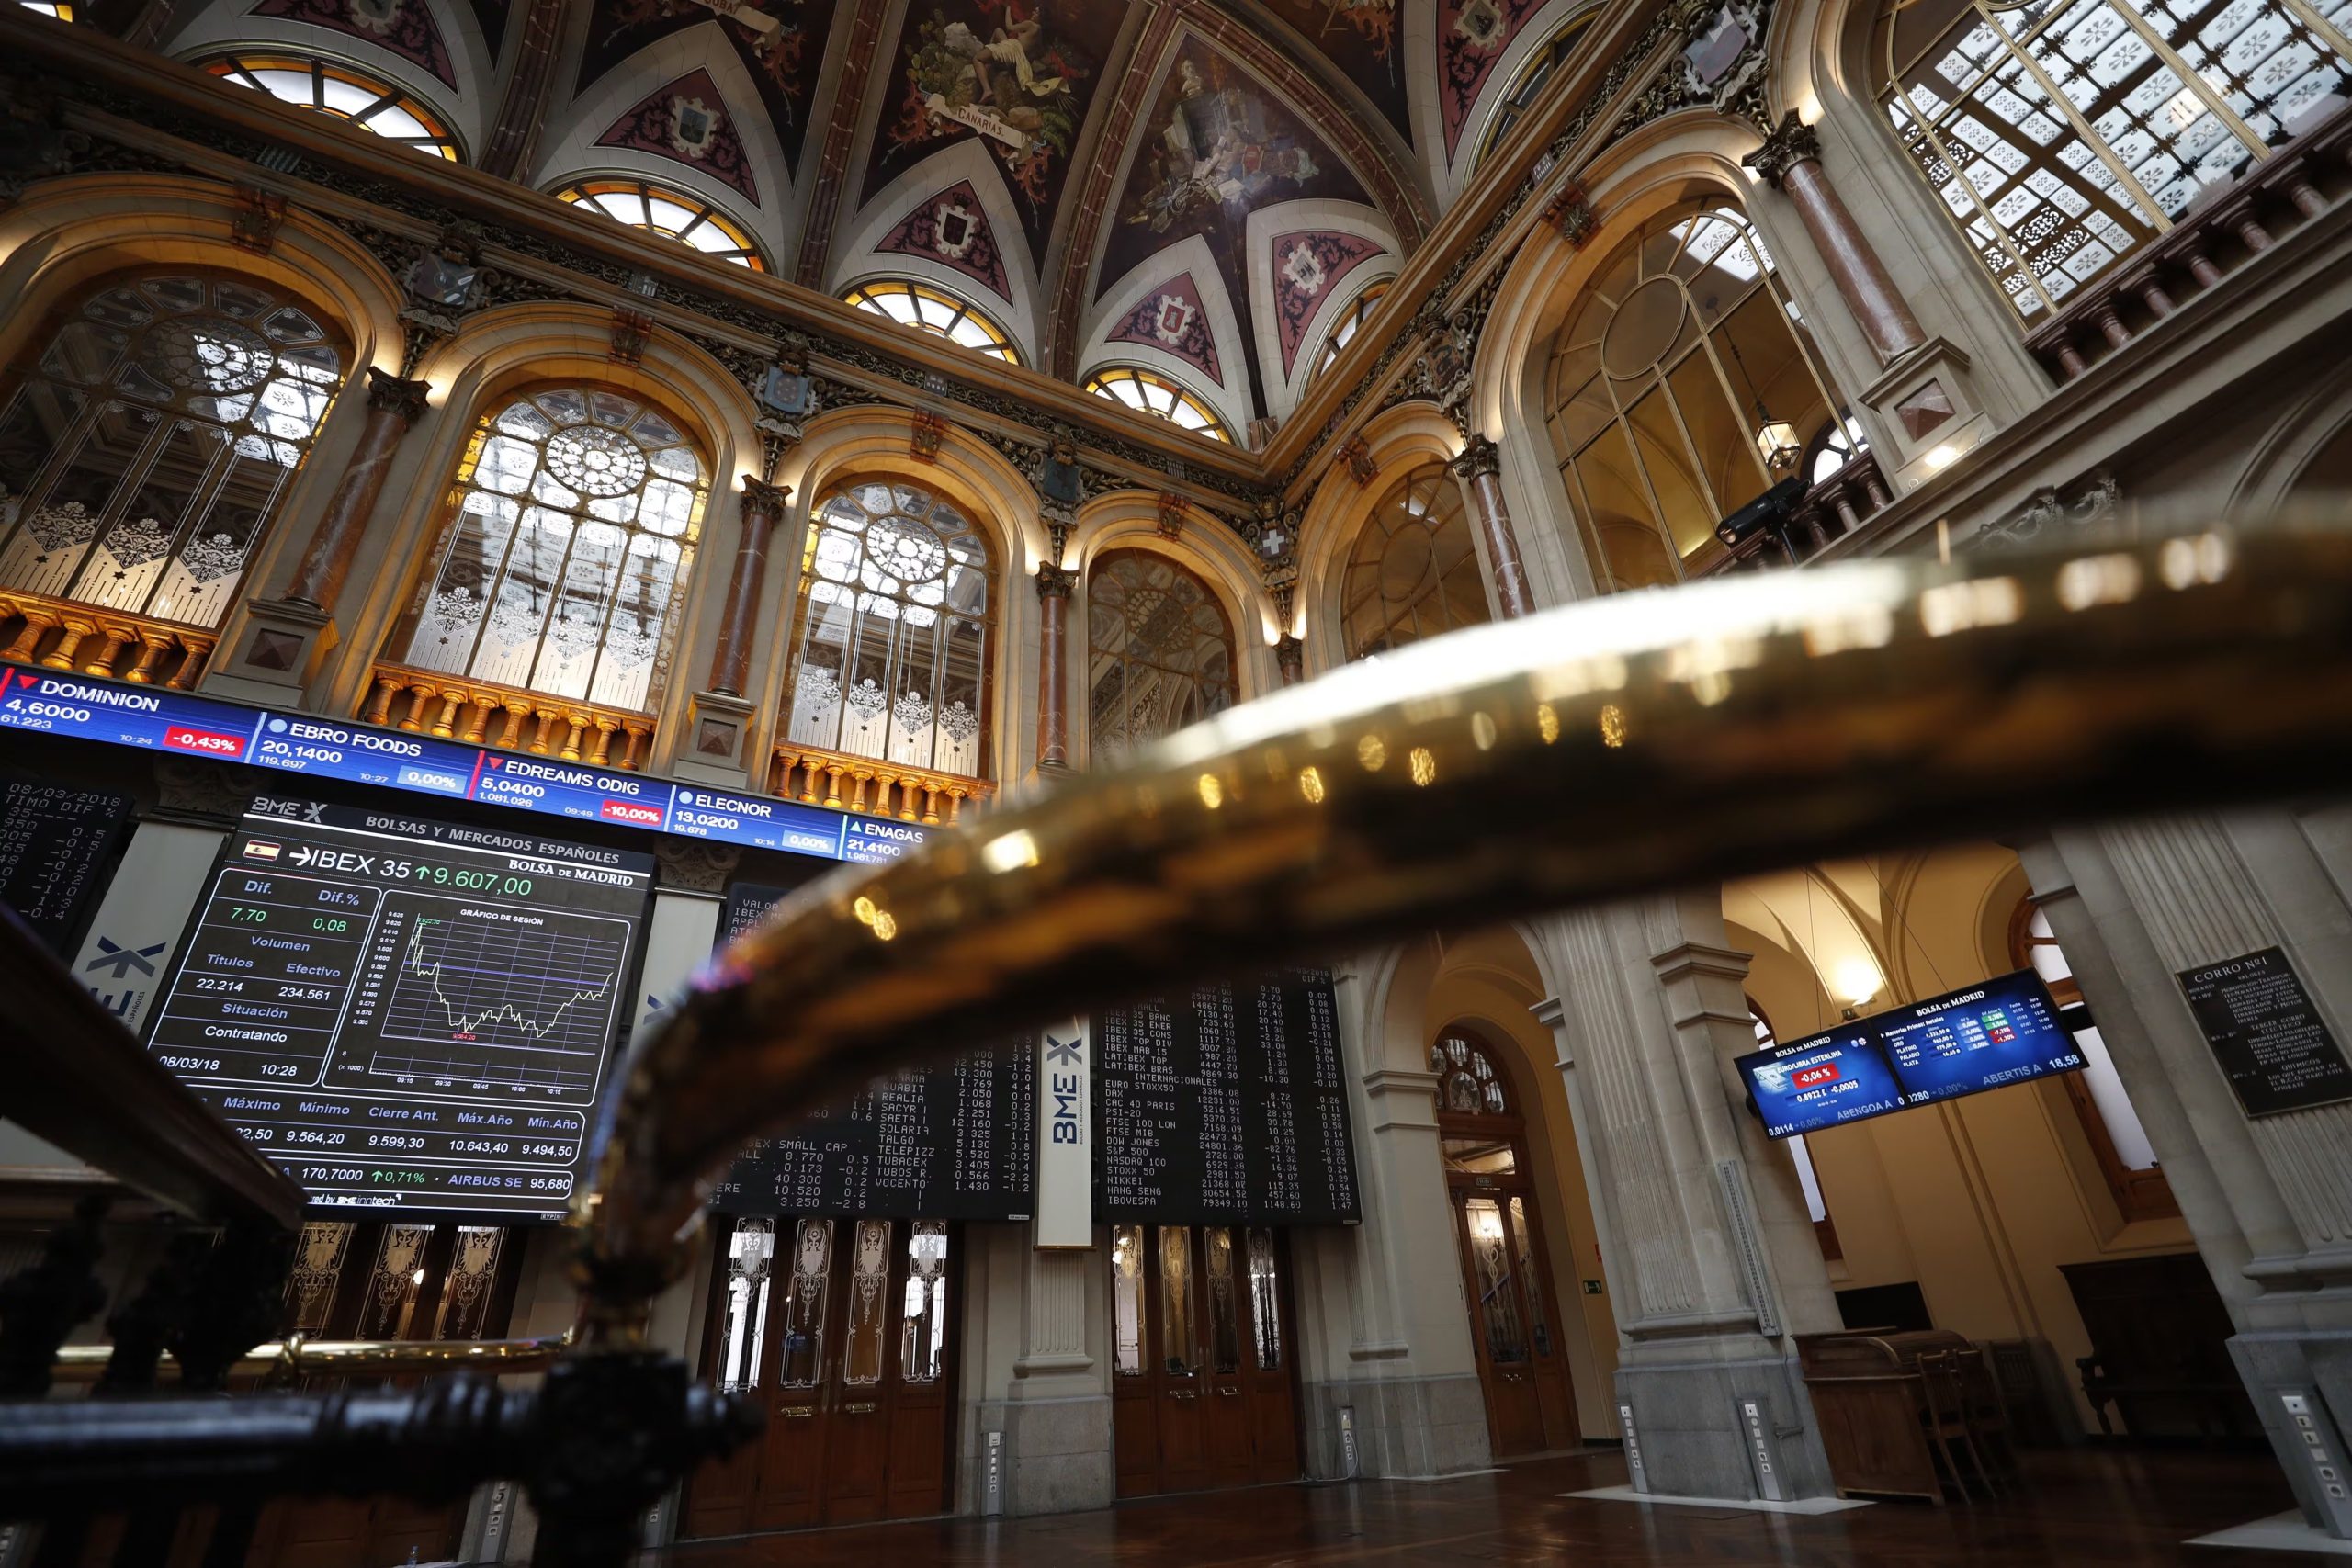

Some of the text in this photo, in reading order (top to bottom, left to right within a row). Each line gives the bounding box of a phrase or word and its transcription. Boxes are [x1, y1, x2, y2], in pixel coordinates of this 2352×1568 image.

[958, 108, 1004, 137] CANARIAS.
[413, 310, 449, 327] SUECIA
[40, 680, 160, 712] DOMINION
[6, 698, 91, 722] 4,6000
[1, 714, 52, 729] 61.223
[120, 733, 236, 753] 10:24 -0,43%
[289, 722, 422, 758] EBRO FOODS
[262, 739, 343, 765] 20,1400
[257, 754, 307, 770] 119.697
[407, 771, 457, 790] 0,00%
[505, 760, 640, 795] EDREAMS ODIG
[9, 783, 121, 807] 08/03/2018
[481, 778, 546, 799] 5,0400
[251, 796, 300, 814] BME
[479, 791, 533, 807] 1.081.026
[695, 794, 772, 818] ELECNOR
[60, 802, 95, 815] DIF
[105, 807, 116, 818] %
[564, 804, 660, 823] 09:49 -10,00%
[675, 810, 739, 831] 13,0200
[673, 823, 707, 837] 19.678
[864, 823, 924, 845] ENAGAS
[365, 816, 620, 865] BOLSAS Y MERCADOS ESPAÑOLES
[789, 834, 830, 850] 0,00%
[847, 838, 901, 857] 21,4100
[310, 849, 533, 896] IBEX 35 9.607,00
[509, 859, 633, 886] BOLSA DE MADRID
[244, 880, 360, 906] Dif. Dif.%
[742, 899, 779, 910] VALOR
[231, 907, 347, 932] 7,70 0,08
[460, 908, 544, 926] GRÁFICO DE SESIÓN
[735, 908, 763, 919] IBEX
[251, 935, 311, 952] Volumen
[207, 953, 341, 977] Títulos Efectivo
[2195, 964, 2241, 983] CORRO
[196, 977, 331, 1000] 22.214 234.561
[128, 991, 145, 1023] ESPAÑOLES
[221, 1002, 288, 1019] Situación
[1916, 1004, 1942, 1018] BOLSA
[1951, 990, 1985, 1007] MADRID
[204, 1025, 288, 1043] Contratando
[1775, 1045, 1796, 1058] BOLSA
[1803, 1036, 1831, 1050] MADRID
[160, 1055, 298, 1077] 08/03/18 10:28
[1105, 1062, 1173, 1074] LATIBEX BRAS
[1777, 1049, 1843, 1074] EURO/LIBRA ESTERLINA
[1903, 1059, 1919, 1067] PLATA
[1983, 1066, 2031, 1085] ABERTIS
[2033, 1064, 2042, 1073] A
[2049, 1054, 2080, 1070] 18,58
[1136, 1073, 1217, 1087] INTERNACIONALES
[1801, 1069, 1822, 1083] -0,06
[1105, 1079, 1174, 1092] EURO STOXX50
[1106, 1089, 1123, 1098] DAX
[882, 1092, 924, 1104] REALIA
[1106, 1099, 1123, 1107] CAC
[1147, 1100, 1175, 1111] PARIS
[223, 1097, 579, 1130] Máximo Mínimo Cierre Ant. Máx.Año Mín.Año
[881, 1103, 916, 1113] SACYR
[1054, 1073, 1077, 1144] BME
[1106, 1108, 1141, 1117] PSI-20
[880, 1113, 916, 1123] SAETA
[1106, 1117, 1176, 1129] FTSE 100 LON
[1769, 1122, 1793, 1136] 0,0114
[1838, 1100, 1883, 1121] ABENGOA
[1885, 1100, 1893, 1109] A
[879, 1134, 914, 1145] TALGO
[1106, 1127, 1153, 1137] FTSE MIB
[286, 1130, 572, 1157] 9.564,20 9.599,30 10.643,40 9.494,50
[779, 1140, 848, 1153] SMALL CAP
[1106, 1136, 1159, 1147] DOW JONES
[878, 1145, 934, 1156] TELEPIZZ
[1107, 1146, 1148, 1156] S&P 500
[877, 1156, 927, 1167] TUBACEX
[1107, 1156, 1166, 1167] NASDAQ 100
[301, 1168, 571, 1190] 170,7000 0,71% AIRBUS SE 95,680
[876, 1167, 912, 1177] TUBOS
[1107, 1166, 1155, 1176] STOXX 50
[876, 1178, 926, 1188] VOCENTO
[1107, 1176, 1143, 1185] NIKKEI
[1108, 1186, 1161, 1196] HANG SENG
[1109, 1196, 1156, 1205] IBOVESPA
